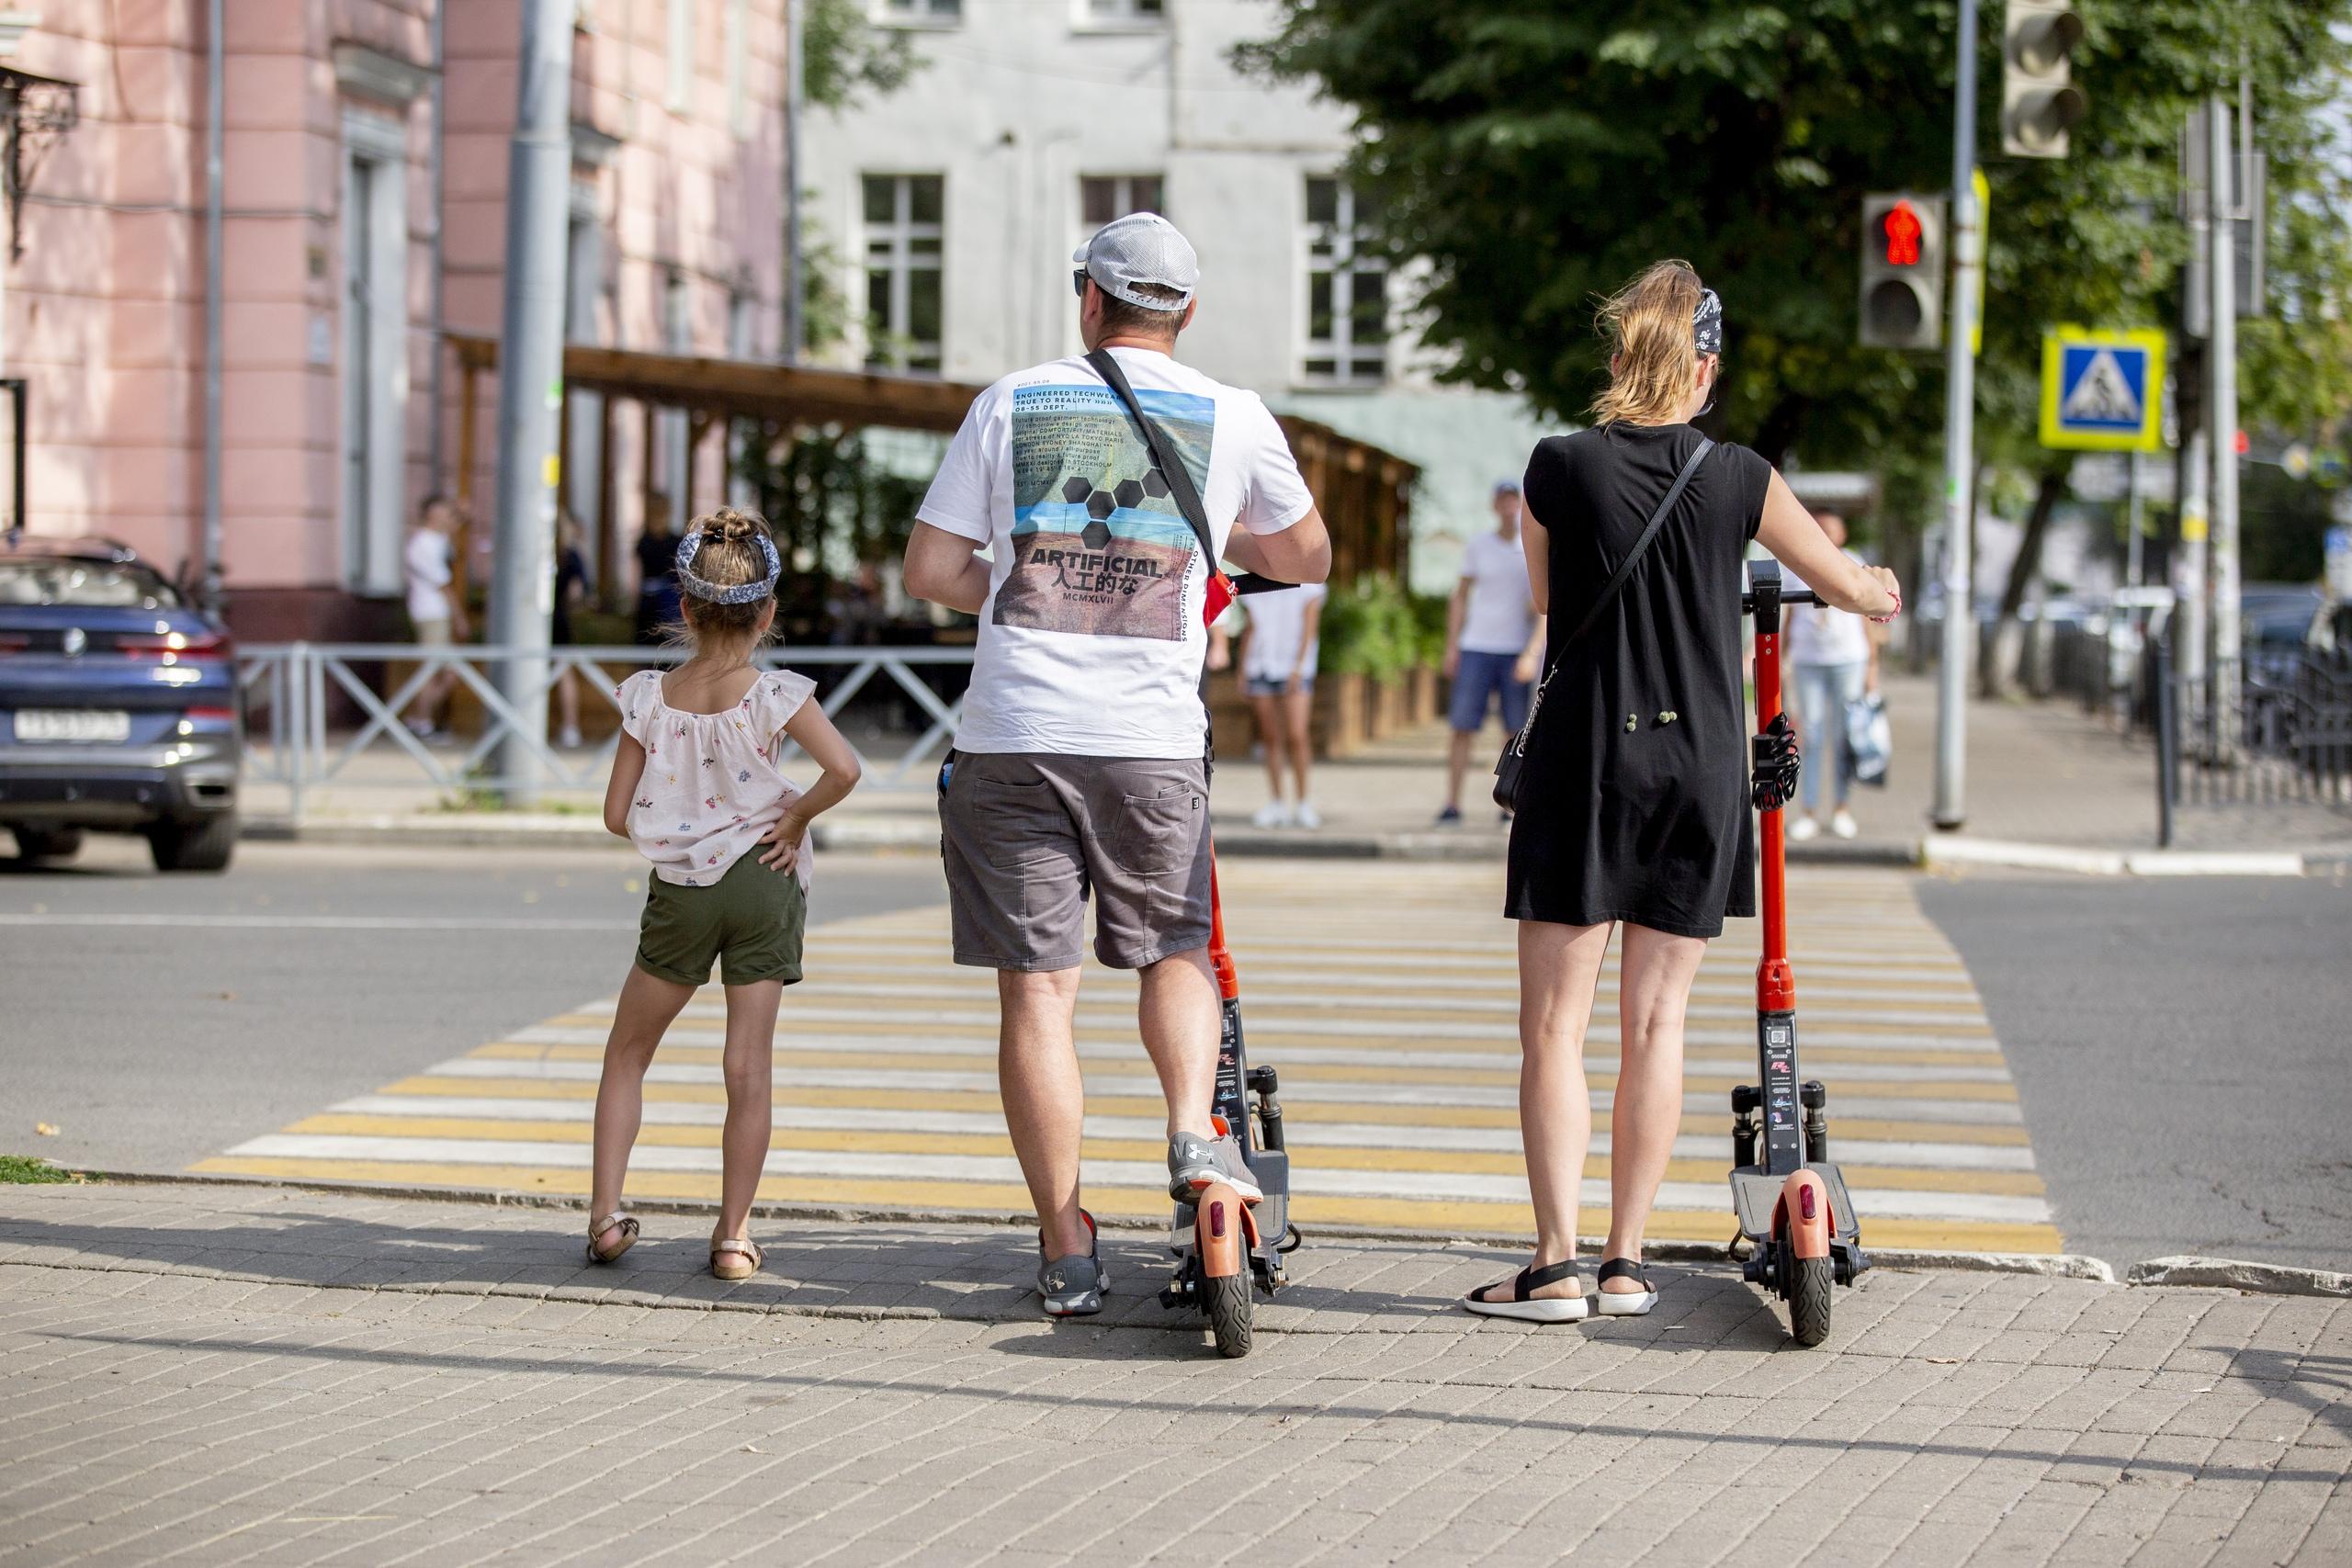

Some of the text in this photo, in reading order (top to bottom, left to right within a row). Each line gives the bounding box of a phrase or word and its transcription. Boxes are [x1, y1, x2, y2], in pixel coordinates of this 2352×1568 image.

[1016, 391, 1070, 399] ENGINEERED
[1081, 416, 1115, 425] technology
[1029, 549, 1163, 578] ARTIFICIAL
[1183, 551, 1198, 581] OTHER
[1051, 568, 1136, 595] 人工的な
[1063, 592, 1114, 604] MCMXLVII
